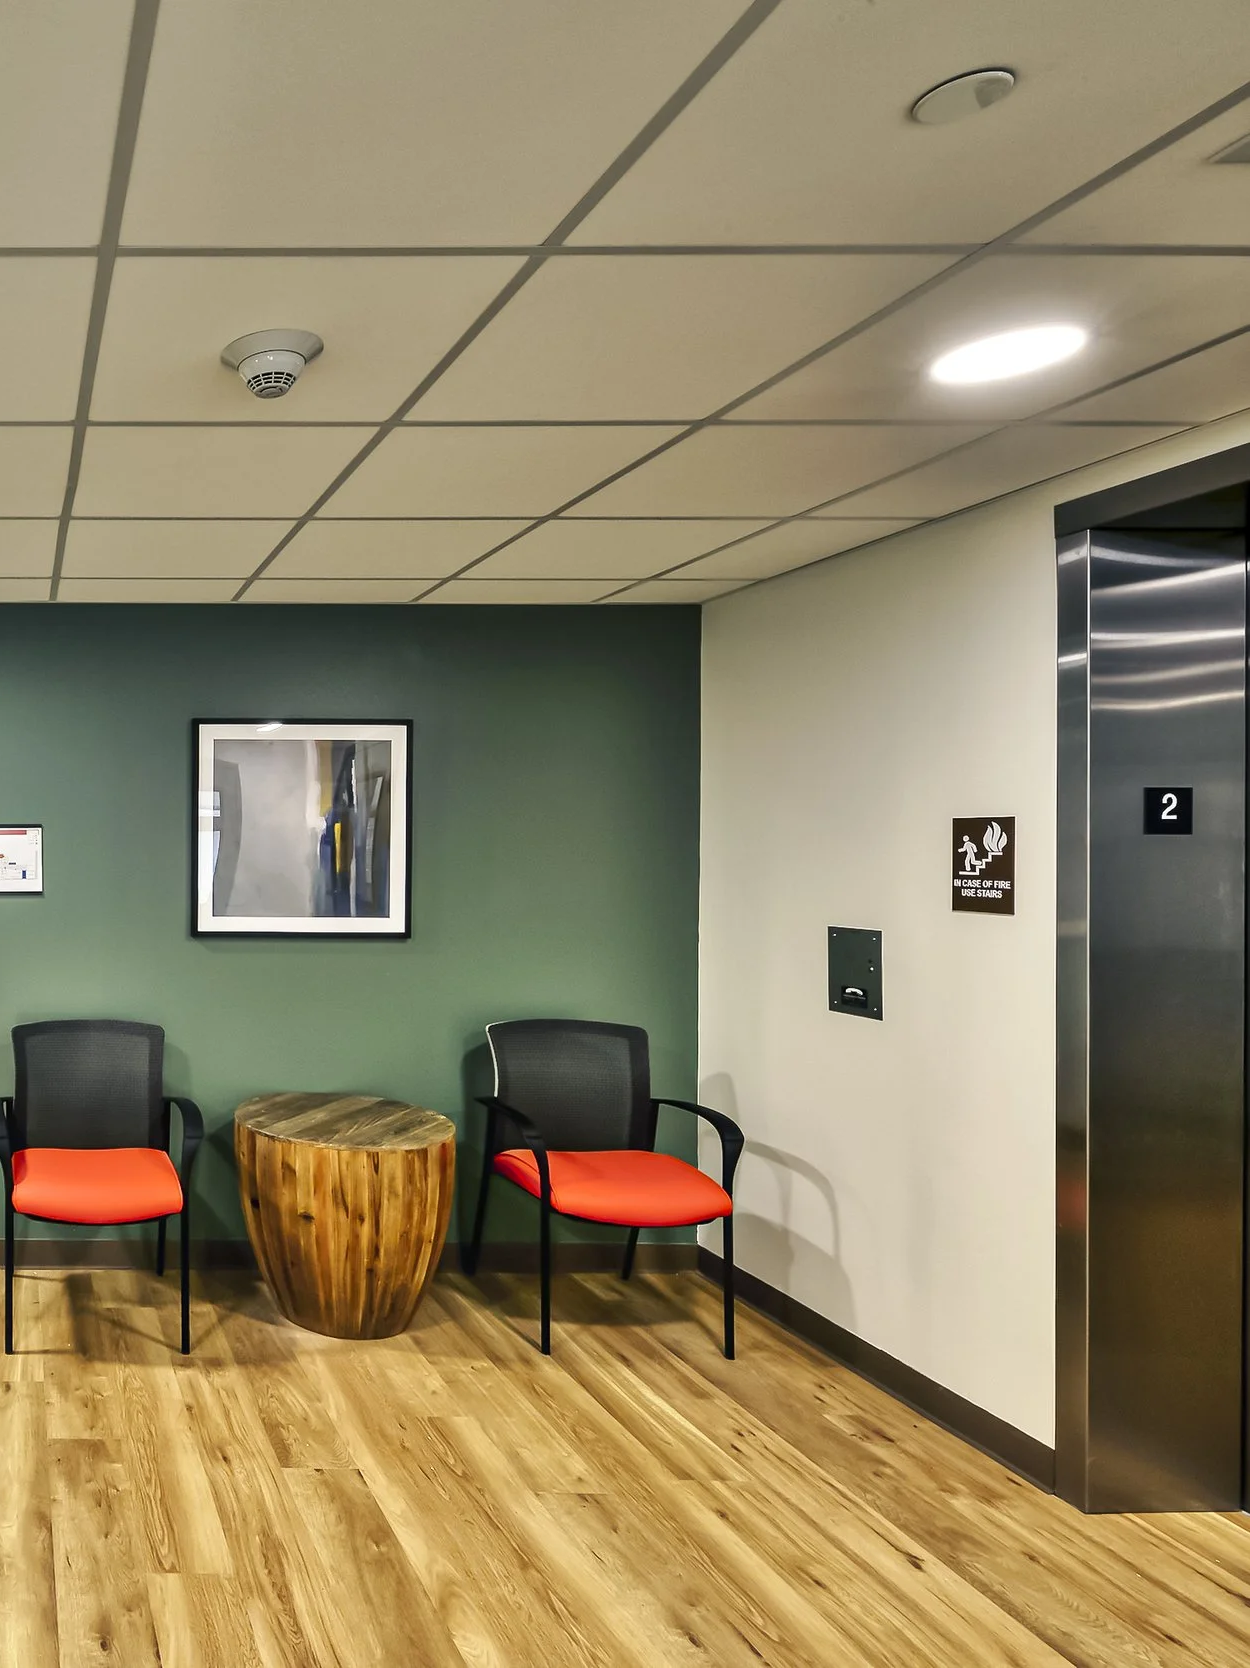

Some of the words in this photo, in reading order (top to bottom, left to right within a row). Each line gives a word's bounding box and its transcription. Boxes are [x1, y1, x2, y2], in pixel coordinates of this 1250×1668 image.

[1161, 793, 1178, 820] 2
[953, 879, 962, 887] IN
[962, 879, 982, 888] CASE
[982, 880, 993, 888] OF
[994, 880, 1012, 889] FIRE
[961, 888, 977, 897] USE
[976, 889, 1003, 899] STAIRS
